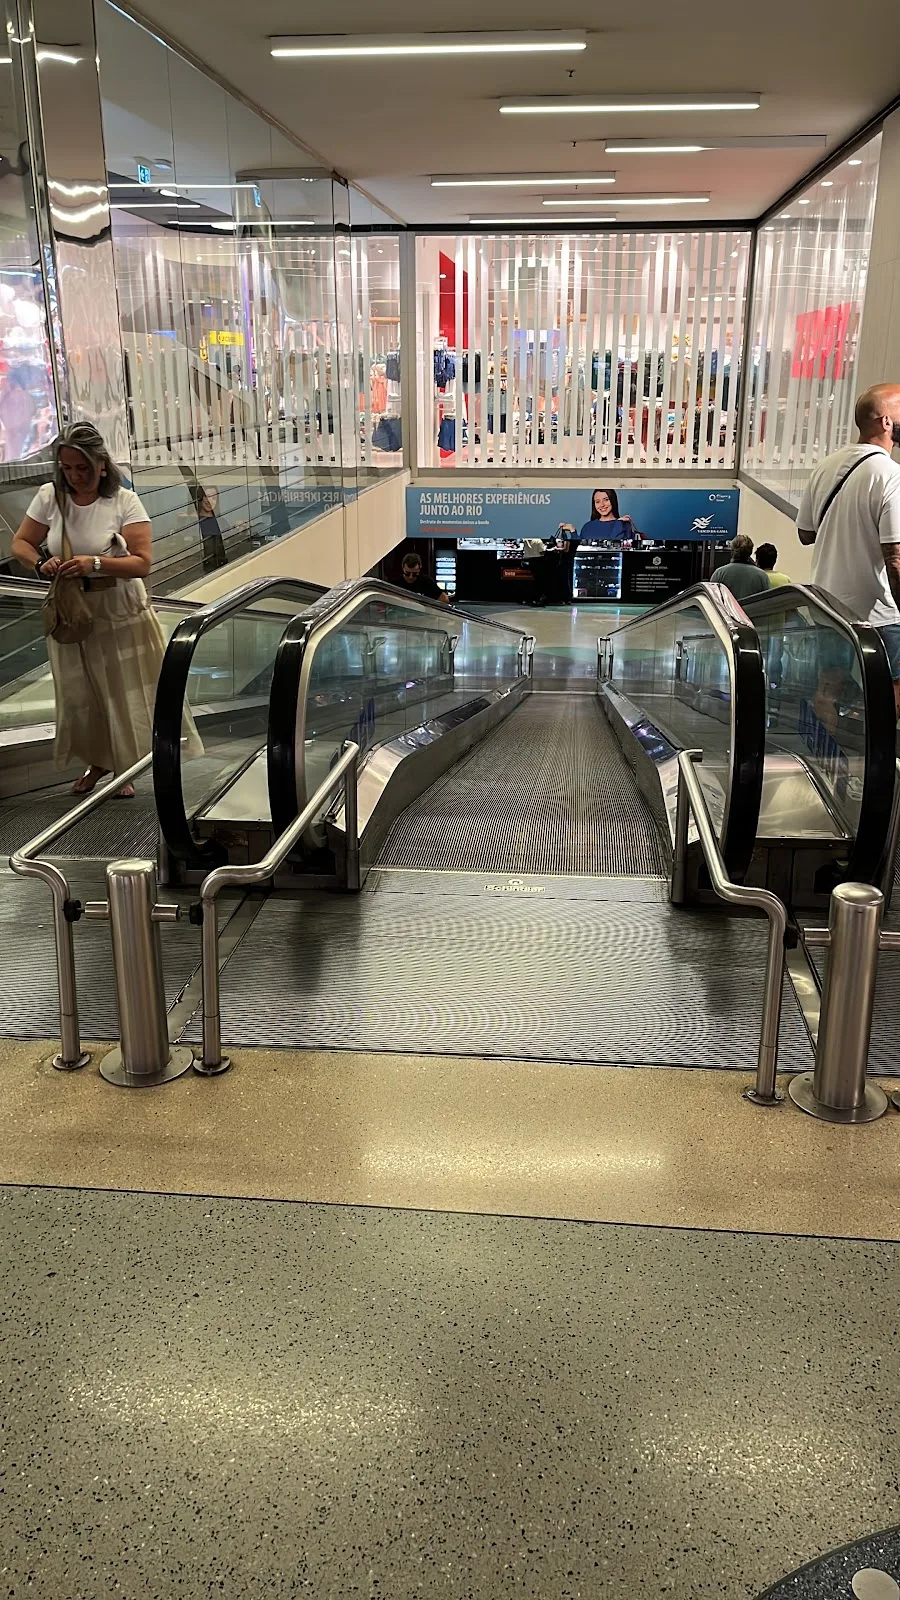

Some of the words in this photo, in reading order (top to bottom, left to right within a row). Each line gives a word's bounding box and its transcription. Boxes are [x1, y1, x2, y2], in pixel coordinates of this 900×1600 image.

[420, 493, 431, 504] AS
[434, 493, 483, 504] MELHORES
[486, 492, 550, 505] EXPERIÊNCIAS
[420, 505, 449, 516] JUNTO
[452, 505, 464, 516] AO
[466, 505, 482, 516] RIO
